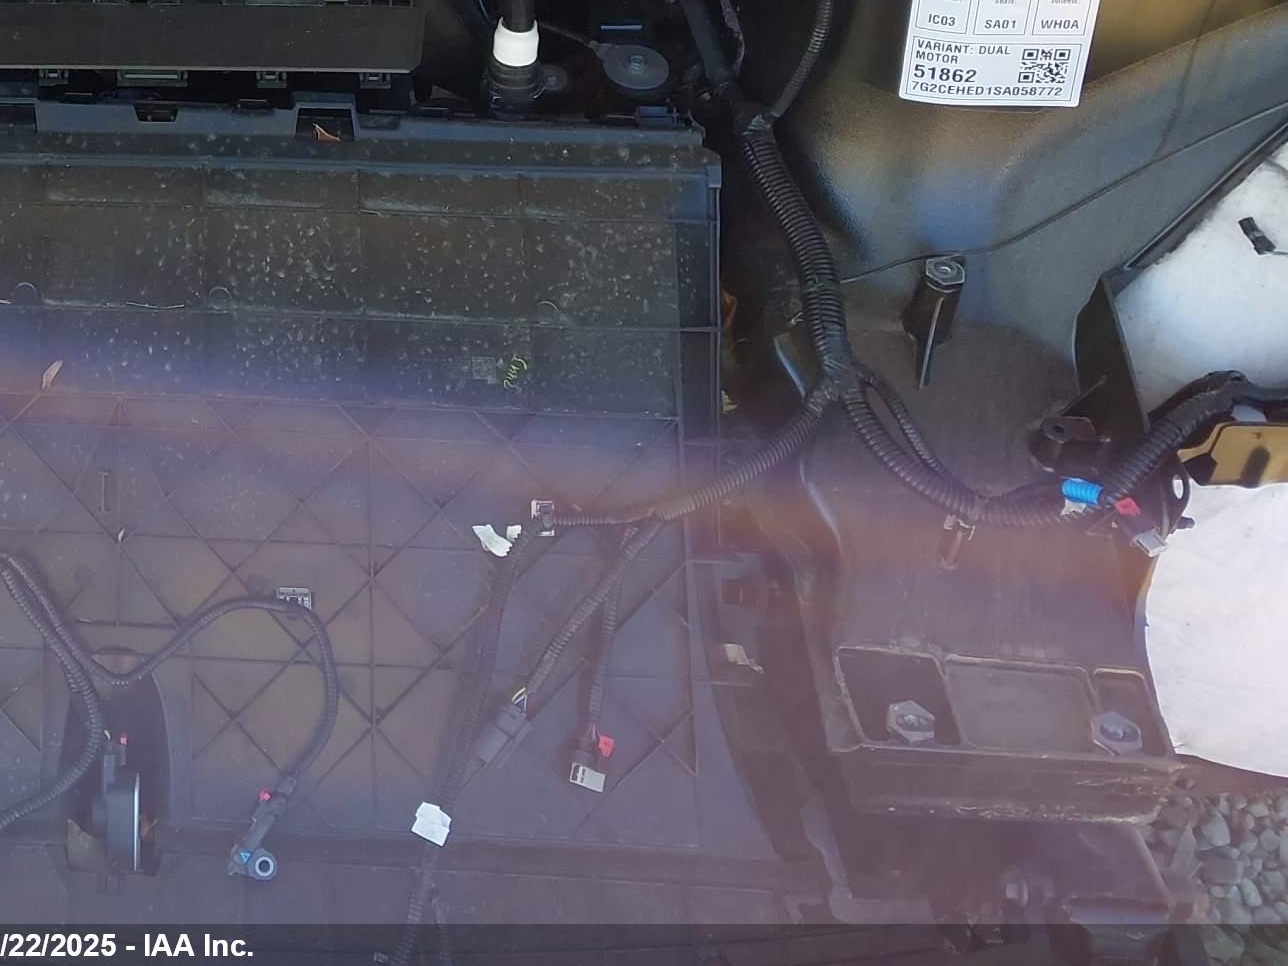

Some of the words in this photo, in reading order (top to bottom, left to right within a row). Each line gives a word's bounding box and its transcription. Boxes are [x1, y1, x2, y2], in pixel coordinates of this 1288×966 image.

[928, 13, 956, 26] IC03
[984, 19, 1017, 29] SA01
[917, 39, 974, 55] VARIANT:
[978, 45, 1011, 55] DUAL
[916, 51, 958, 64] MOTOR
[914, 64, 977, 83] 51862
[912, 81, 1063, 96] 7G2CEHED1SA058772
